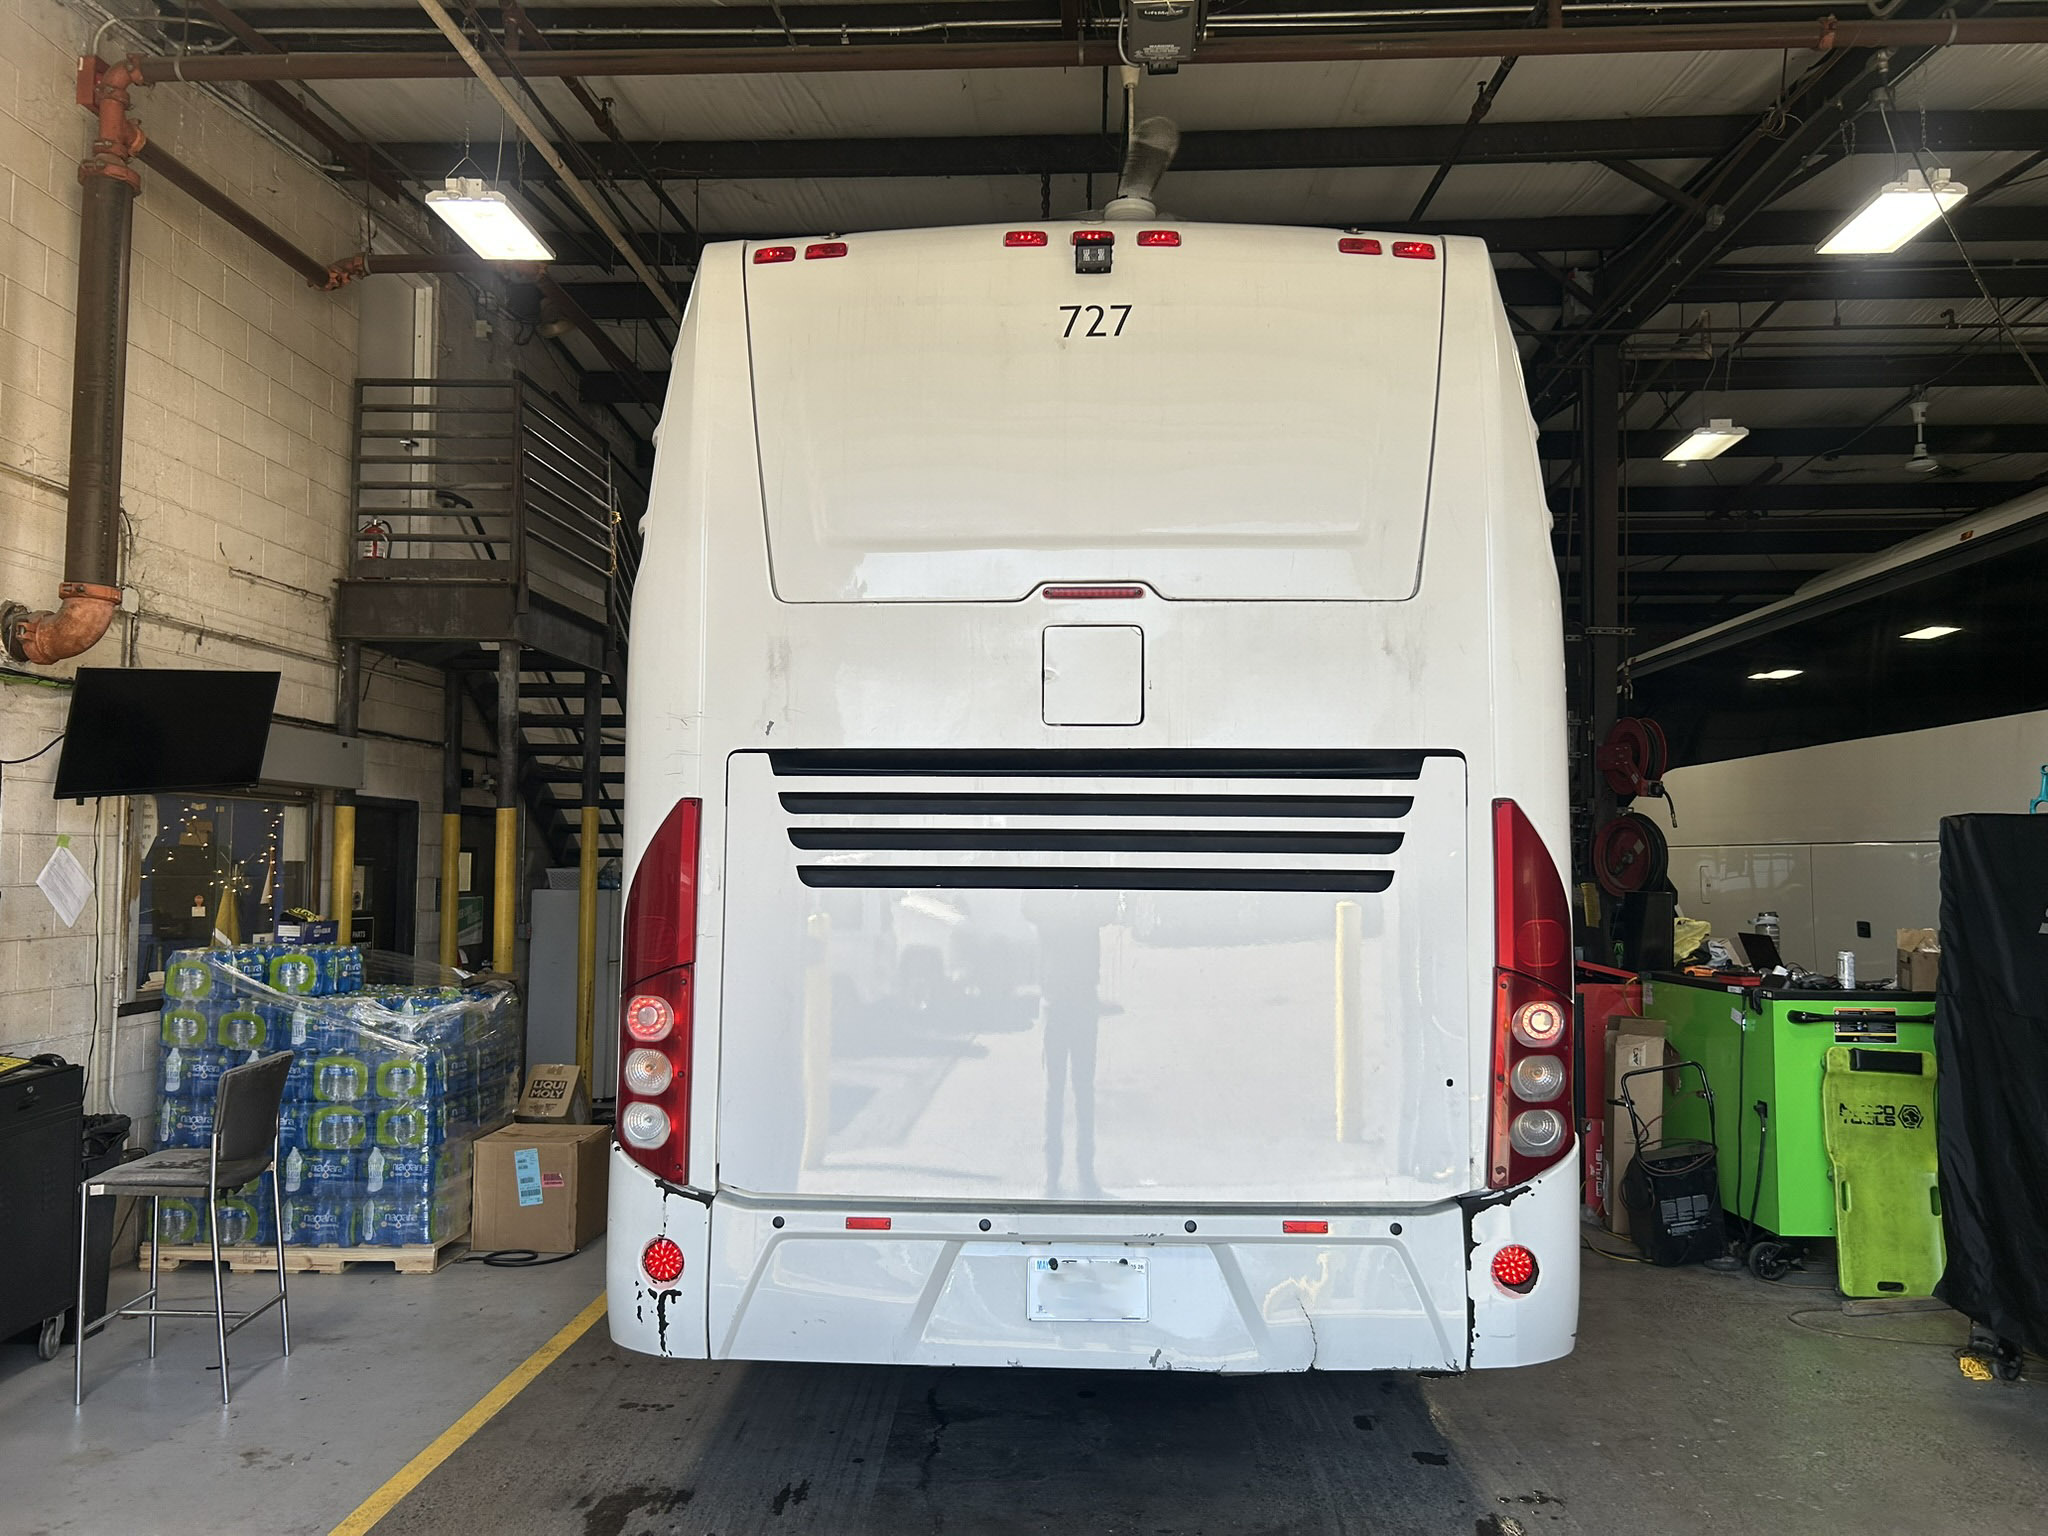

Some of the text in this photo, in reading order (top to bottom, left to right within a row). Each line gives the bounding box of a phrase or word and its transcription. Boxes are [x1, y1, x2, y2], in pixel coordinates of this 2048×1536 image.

[1059, 304, 1133, 338] 727
[533, 1080, 567, 1090] LIQUI
[530, 1089, 565, 1099] MOLY
[1595, 1144, 1603, 1180] FUEL
[303, 1212, 337, 1229] nagara
[384, 1212, 418, 1229] nagara
